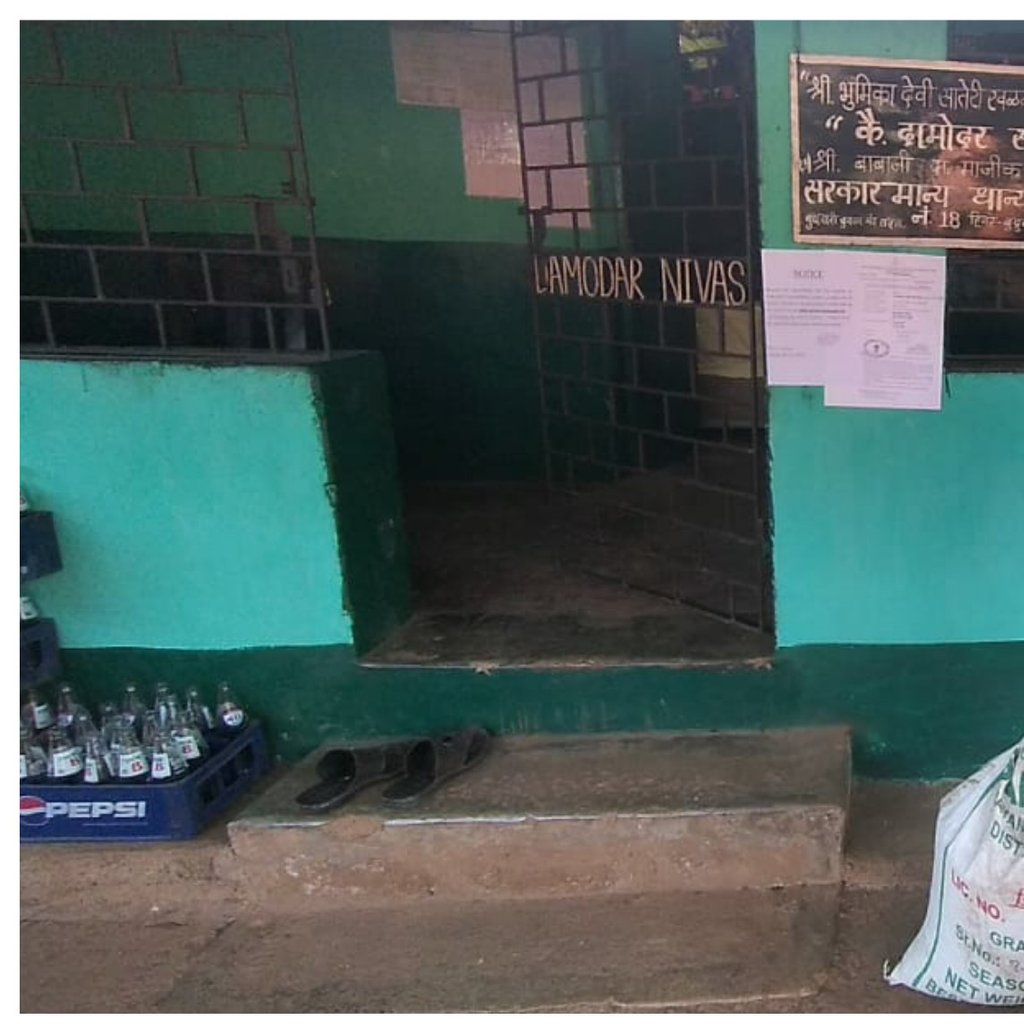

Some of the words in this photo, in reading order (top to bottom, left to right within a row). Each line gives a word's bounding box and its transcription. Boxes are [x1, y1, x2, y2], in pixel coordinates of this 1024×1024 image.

[901, 75, 937, 108] देवी
[898, 113, 994, 150] दामोदर
[804, 179, 881, 205] सरकार
[891, 182, 950, 208] मान्य
[940, 211, 961, 230] 18
[661, 257, 747, 306] NIVAS
[46, 800, 147, 818] PEPSI
[976, 896, 1006, 922] NO.
[945, 966, 981, 1000] NET
